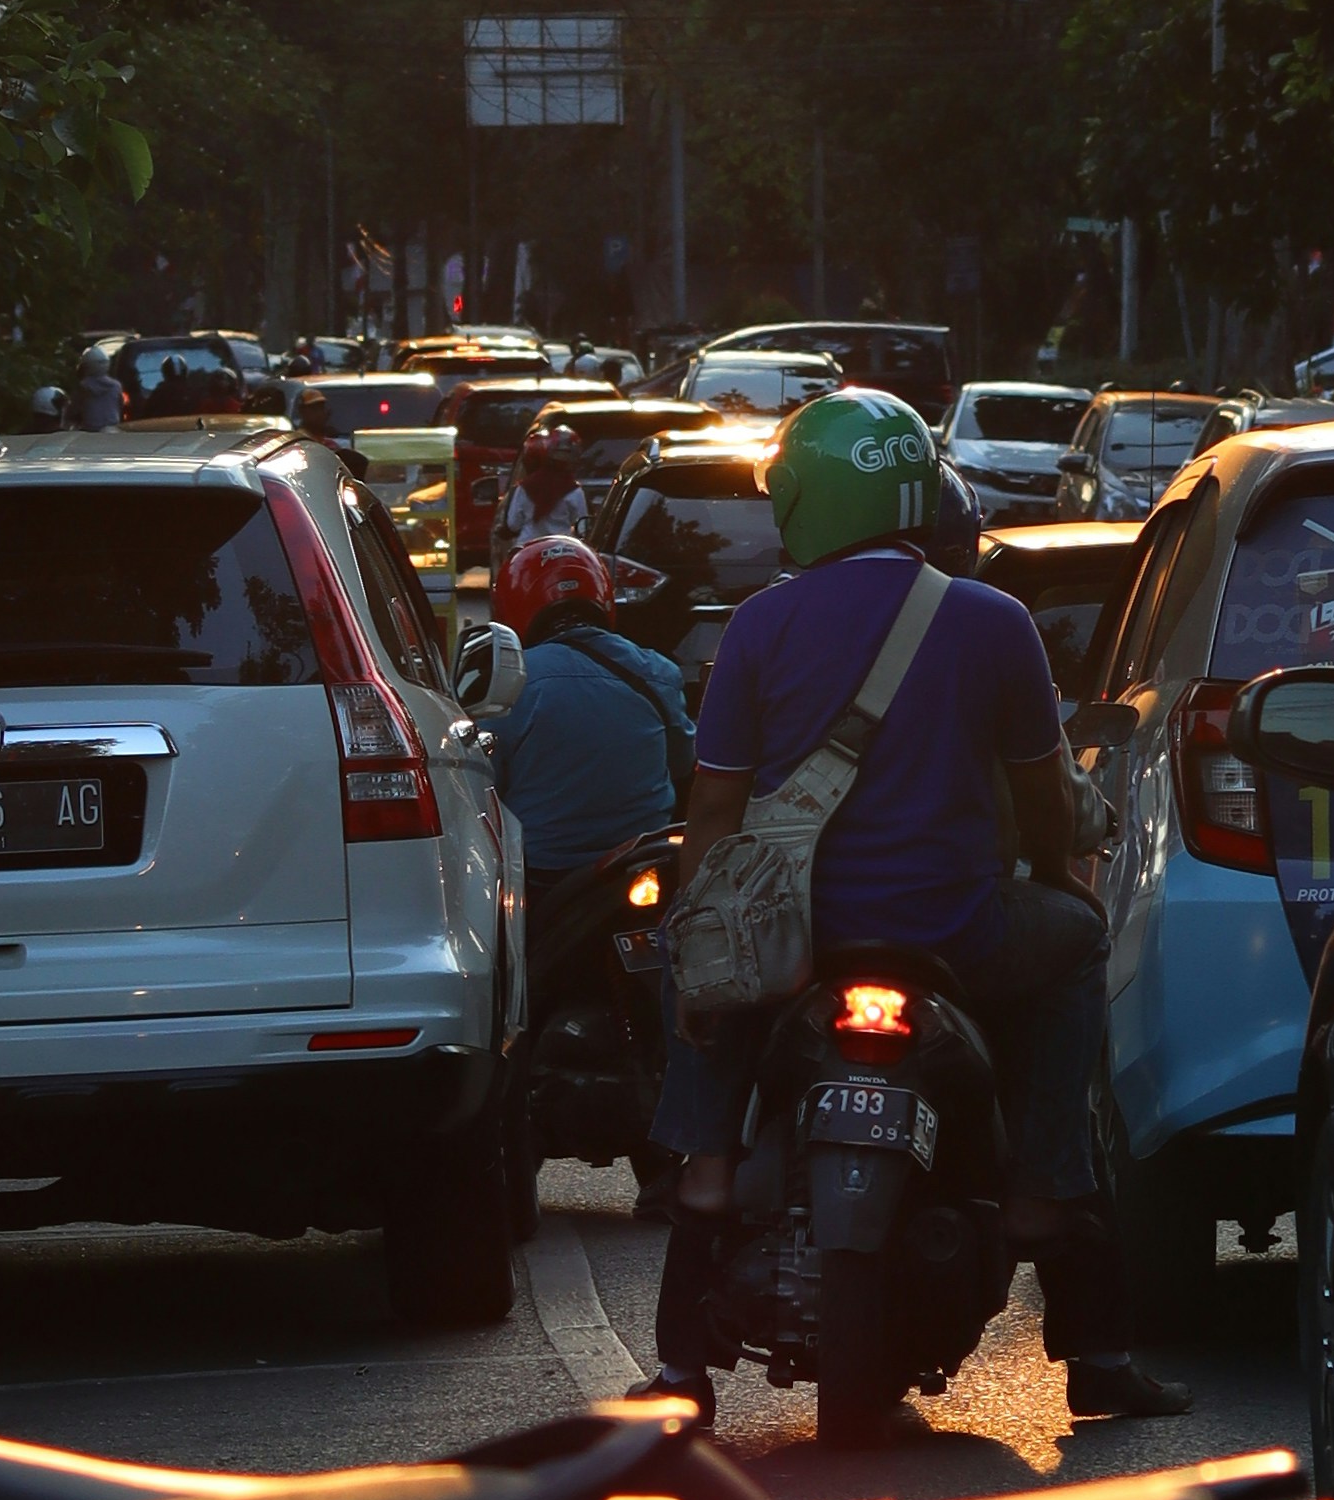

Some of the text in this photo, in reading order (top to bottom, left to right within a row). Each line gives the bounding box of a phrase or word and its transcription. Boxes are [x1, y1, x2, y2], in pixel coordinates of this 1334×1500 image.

[57, 783, 100, 827] AG
[618, 936, 633, 952] D
[848, 1075, 888, 1085] HONDA
[817, 1088, 885, 1115] 4193
